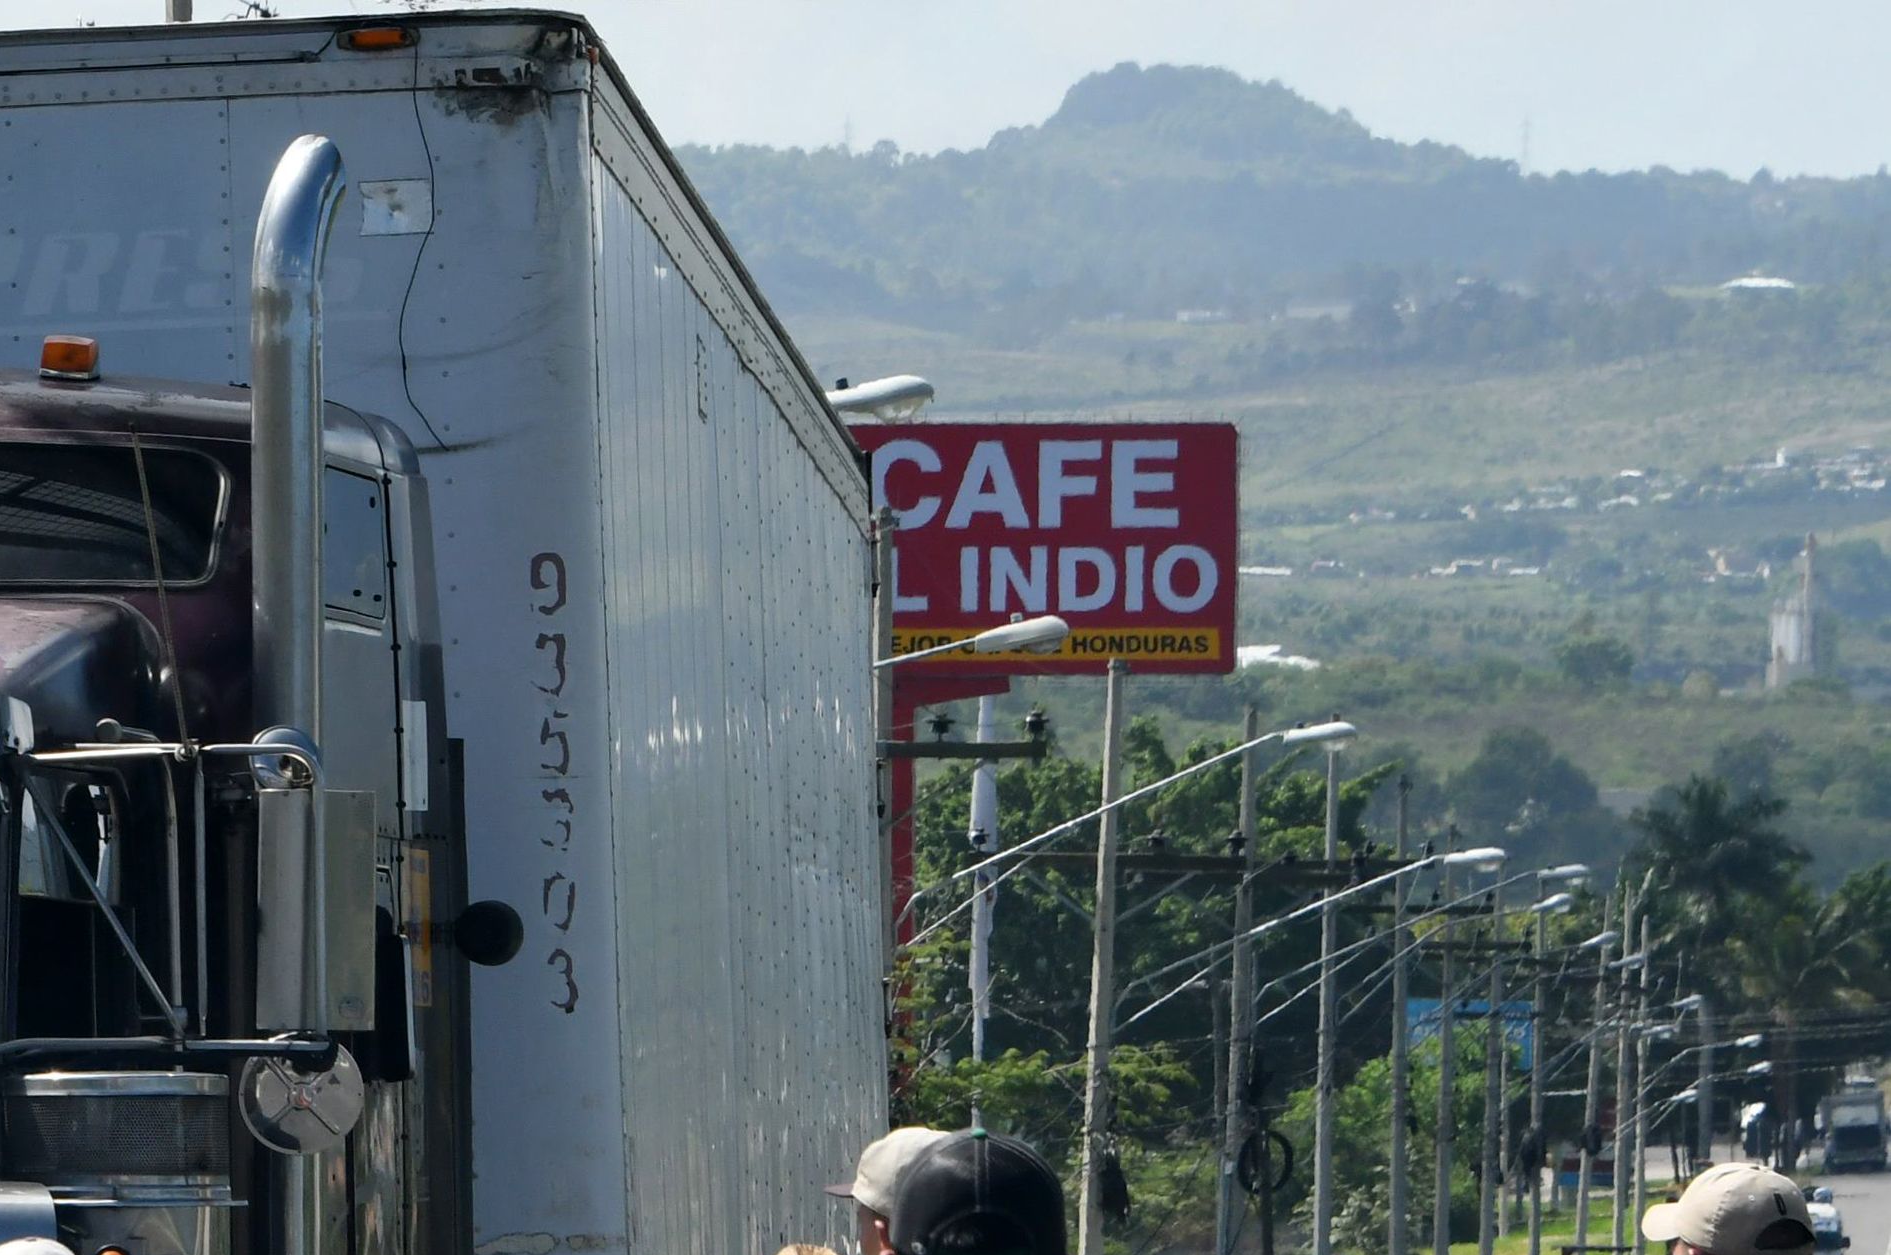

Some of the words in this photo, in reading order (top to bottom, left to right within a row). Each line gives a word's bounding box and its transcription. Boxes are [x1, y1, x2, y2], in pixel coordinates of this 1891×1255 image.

[872, 438, 1180, 531] CAFE
[960, 544, 1219, 613] INDIO
[1071, 634, 1209, 653] HONDURAS
